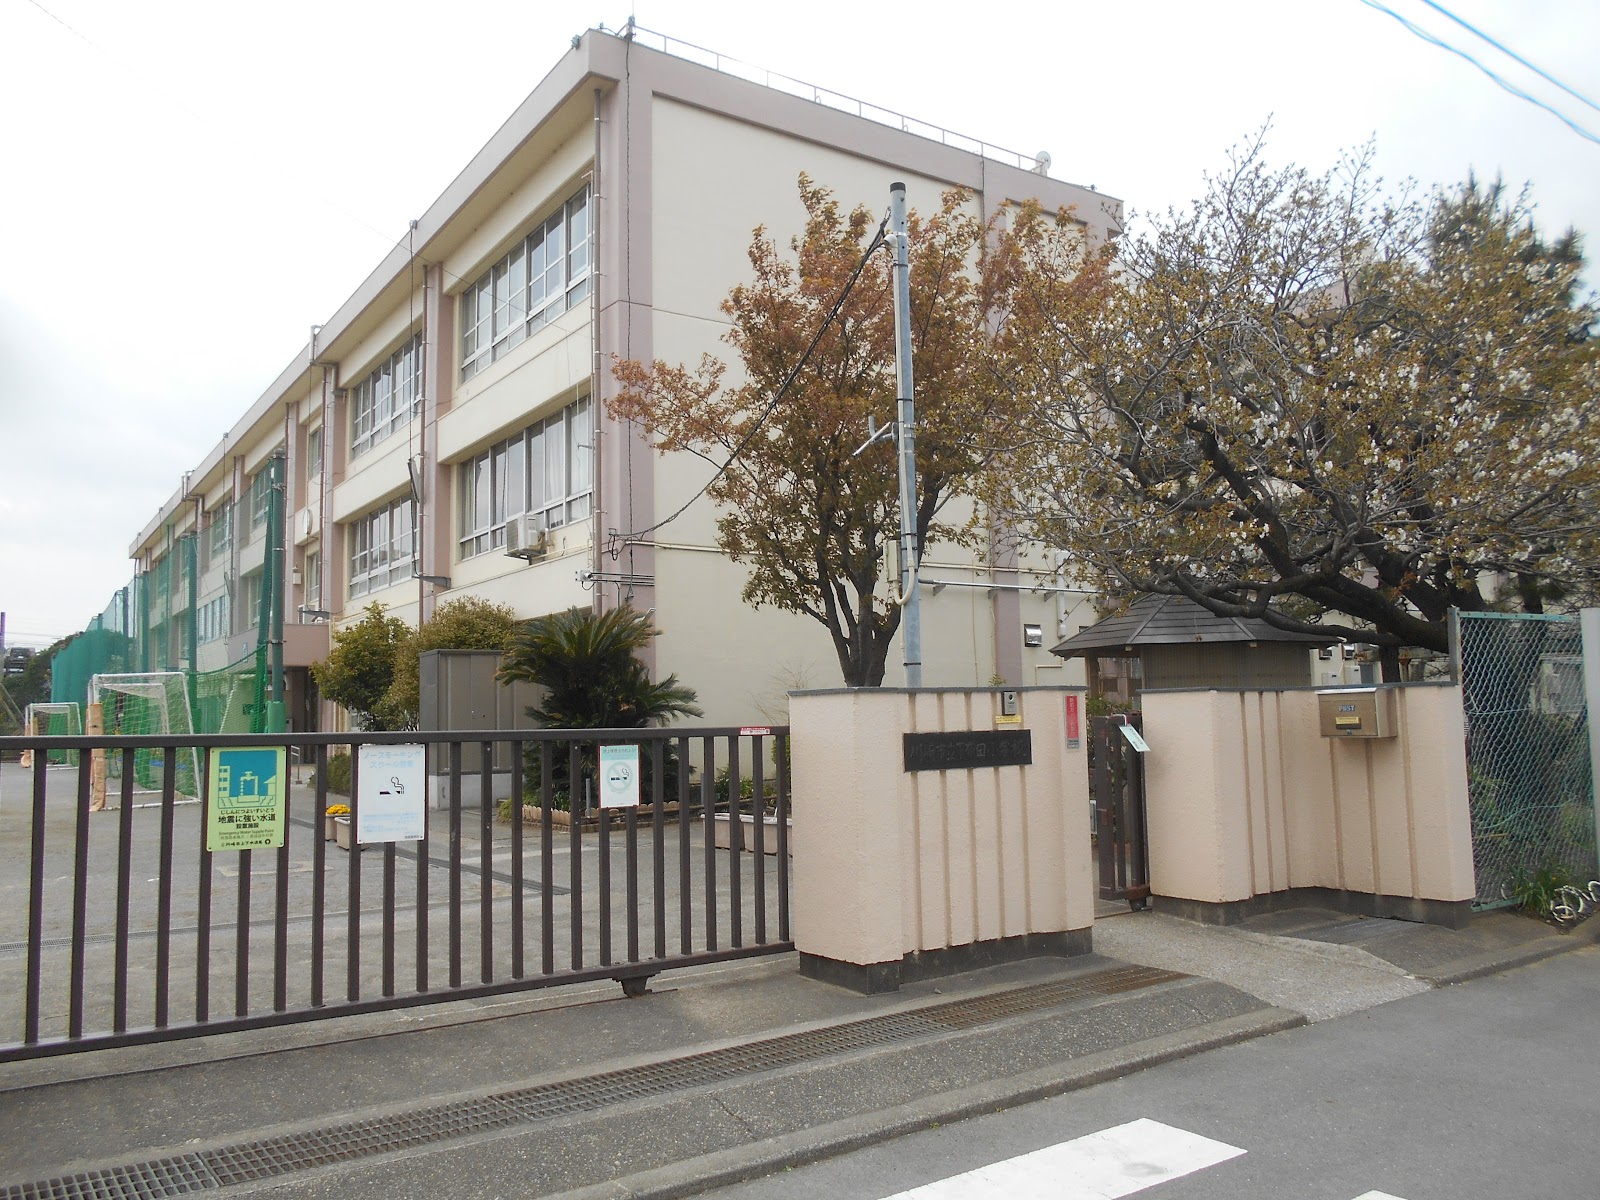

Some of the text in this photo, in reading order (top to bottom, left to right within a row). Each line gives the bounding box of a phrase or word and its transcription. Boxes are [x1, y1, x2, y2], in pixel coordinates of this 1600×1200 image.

[1338, 704, 1356, 712] POST
[218, 814, 276, 823] 地震に強い水道
